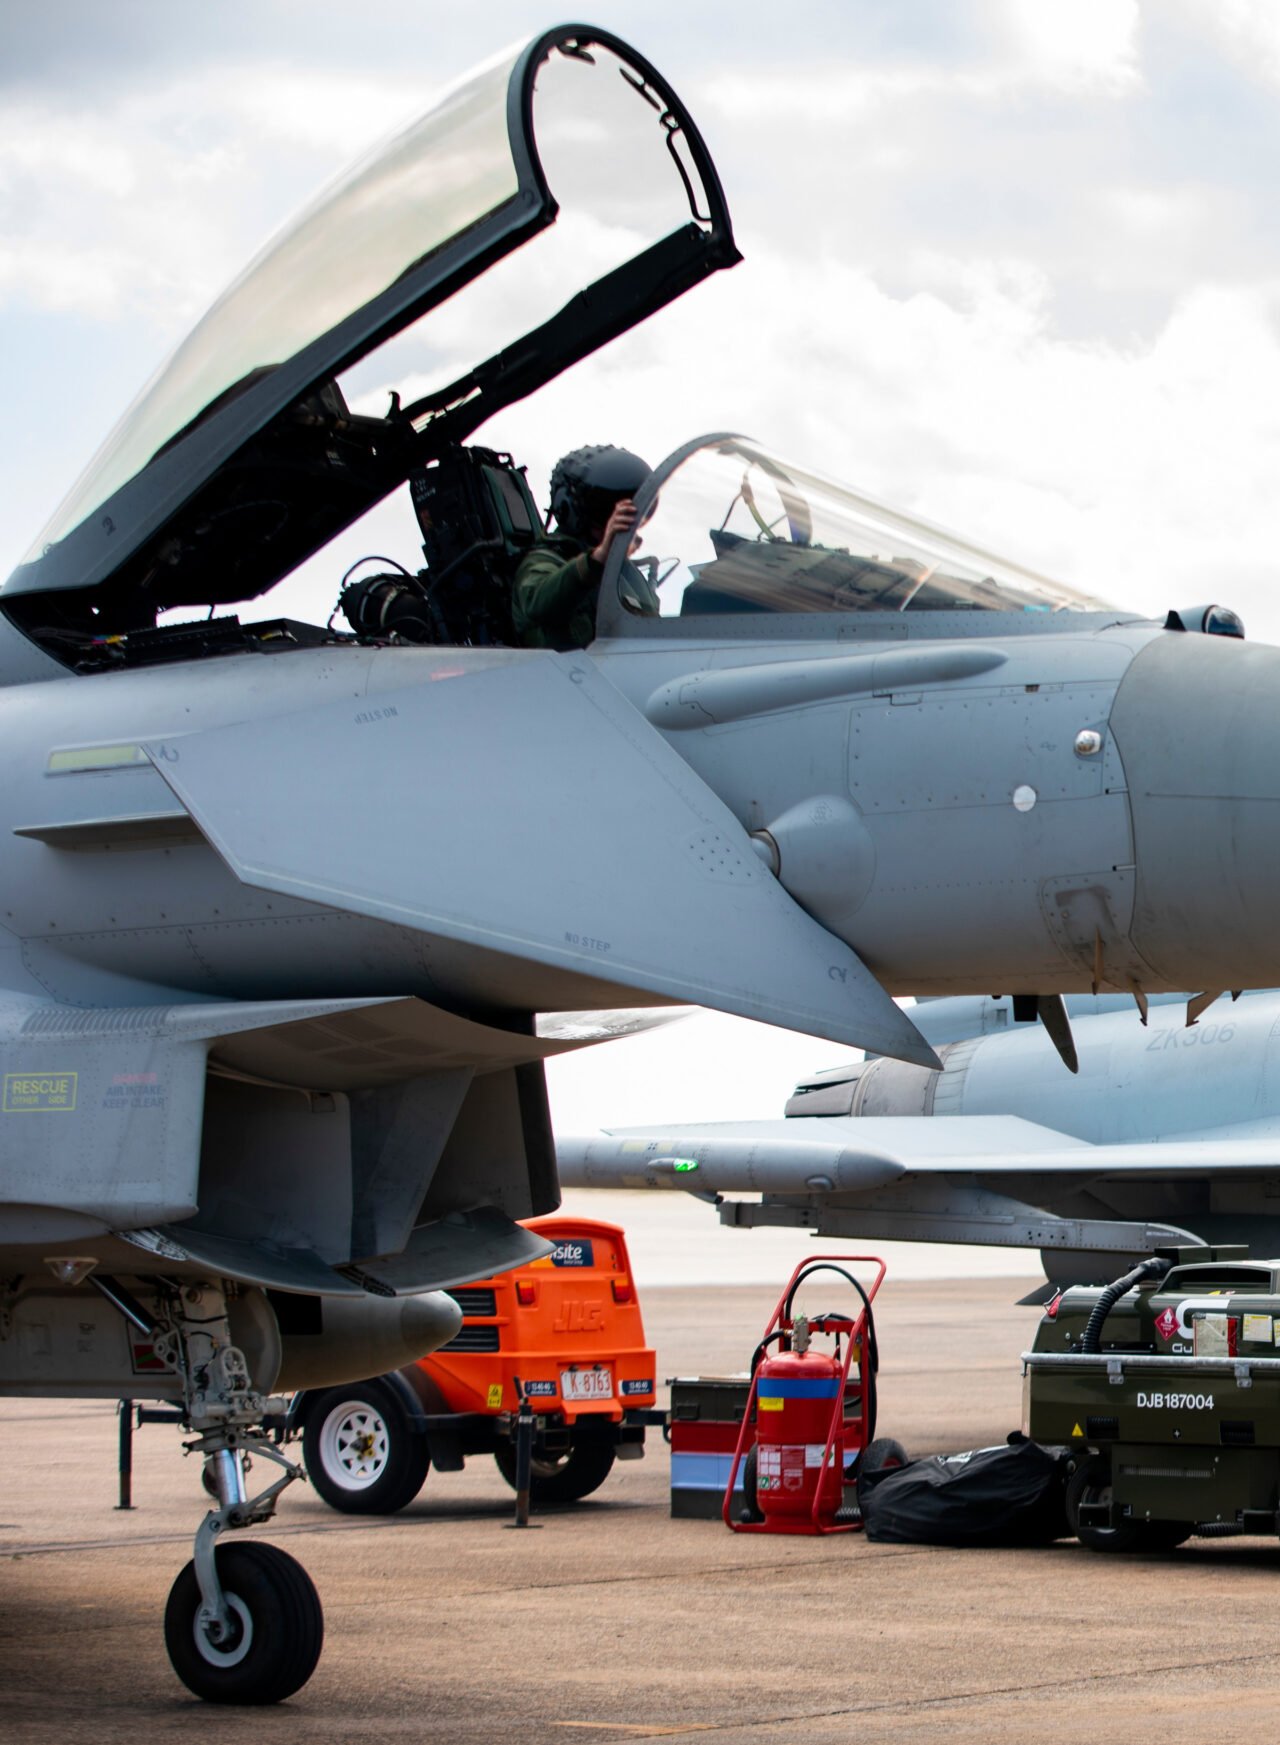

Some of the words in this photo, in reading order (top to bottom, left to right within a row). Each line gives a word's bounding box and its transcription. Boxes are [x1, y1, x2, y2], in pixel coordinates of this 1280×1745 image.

[582, 936, 611, 952] STEP
[1145, 1022, 1237, 1052] ZK306
[12, 1080, 69, 1095] RESCUE
[1137, 1392, 1215, 1410] DJB187004
